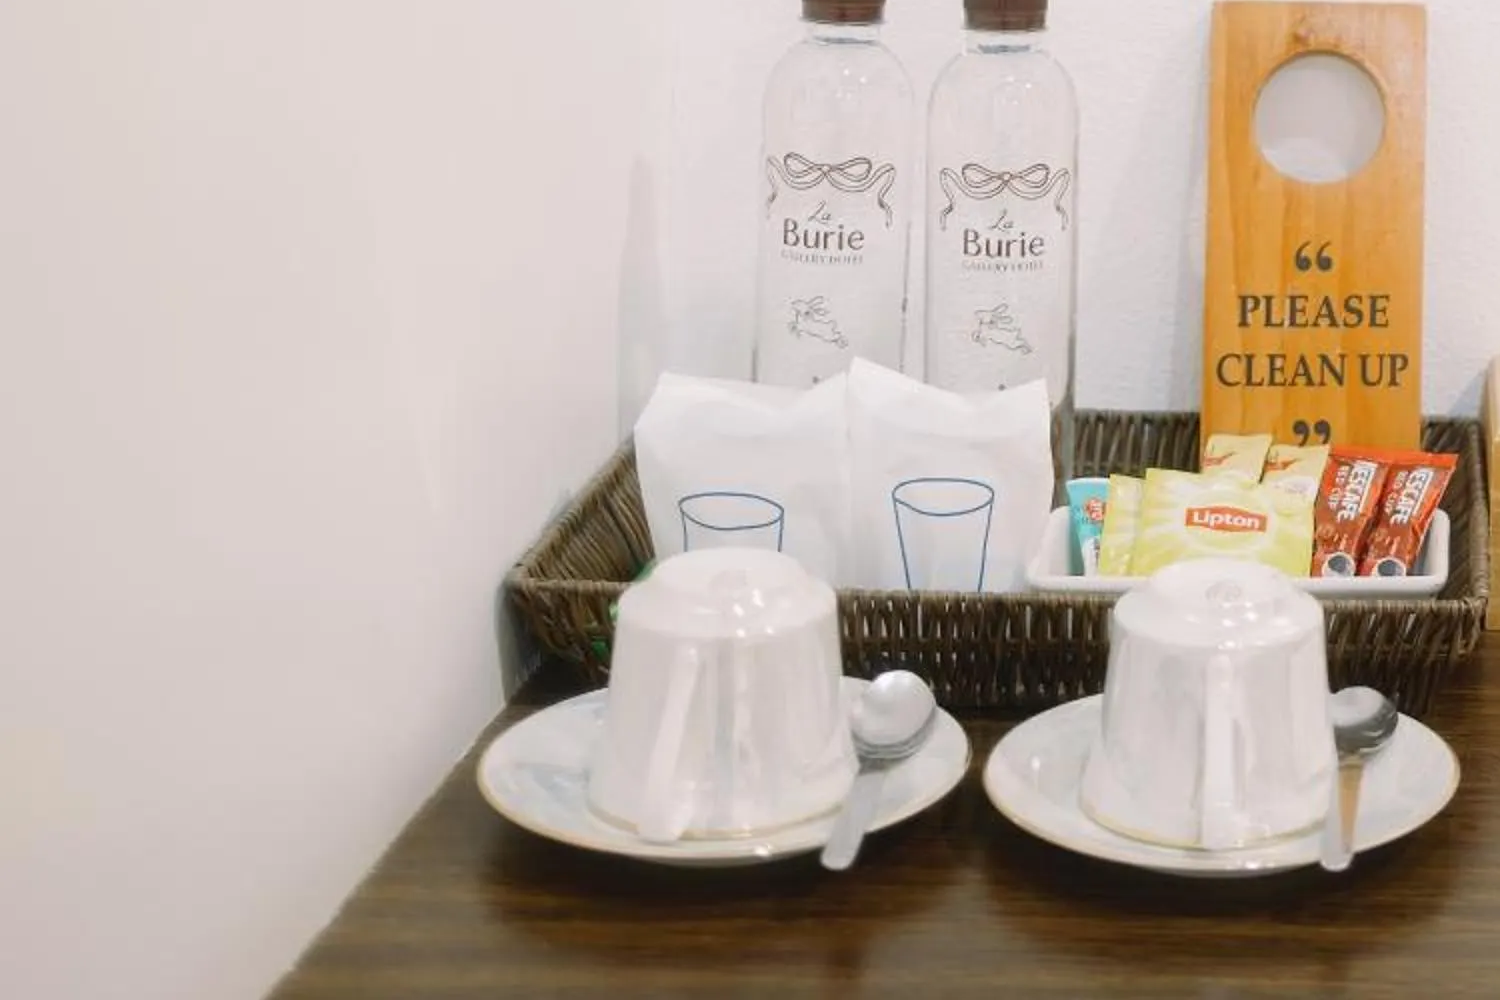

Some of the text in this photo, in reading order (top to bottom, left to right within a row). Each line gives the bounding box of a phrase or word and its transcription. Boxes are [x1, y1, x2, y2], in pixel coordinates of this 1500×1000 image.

[782, 218, 865, 251] Burie
[962, 228, 1045, 258] Burie
[1237, 294, 1391, 329] PLEASE
[1216, 353, 1410, 387] CLEAN UP
[1193, 510, 1260, 529] Lipton
